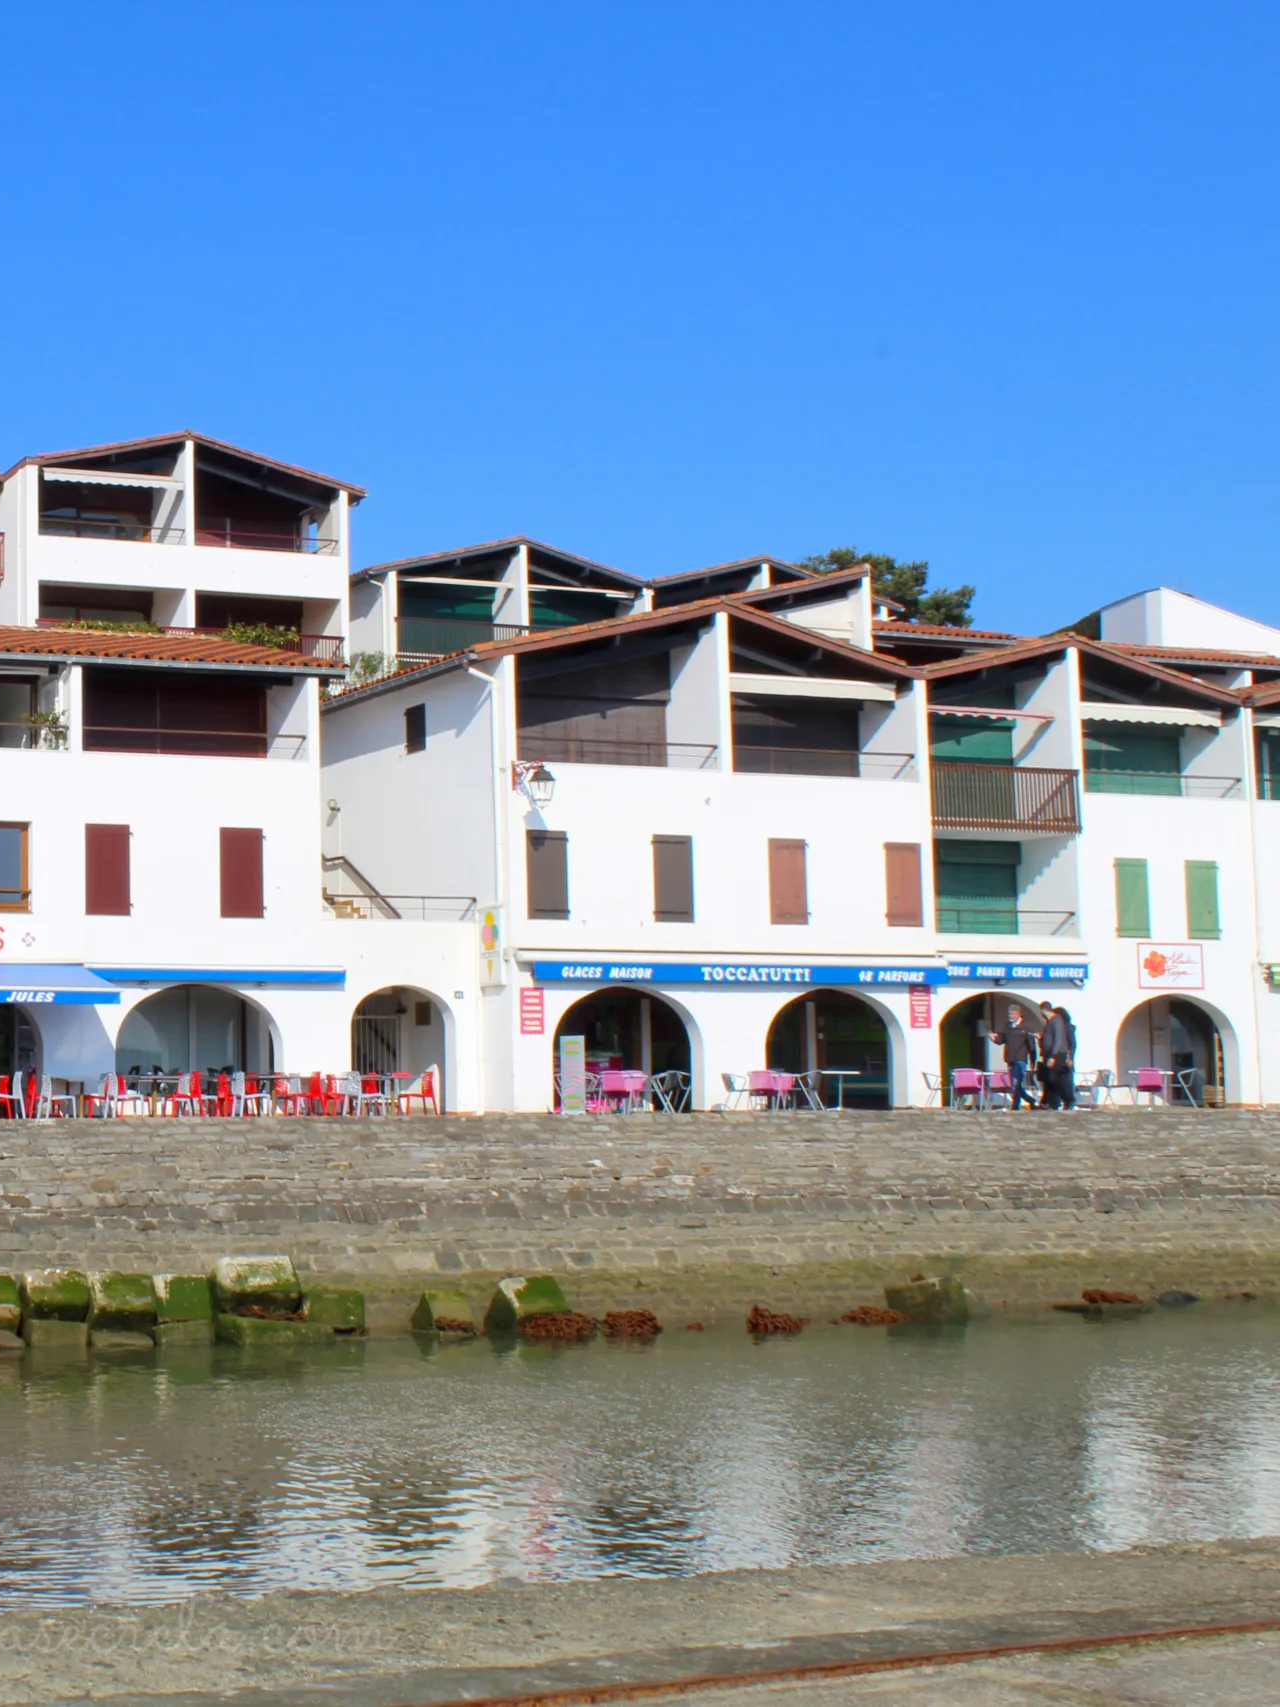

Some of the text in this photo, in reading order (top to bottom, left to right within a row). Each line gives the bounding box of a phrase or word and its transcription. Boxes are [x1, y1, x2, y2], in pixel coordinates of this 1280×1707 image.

[561, 966, 653, 979] GLACES MAISON
[701, 967, 811, 981] TOCCATUTTI
[878, 971, 924, 982] PARFUMS
[975, 966, 1006, 977] PANINI
[1049, 967, 1085, 978] GAUFRES
[6, 991, 55, 1003] JULES
